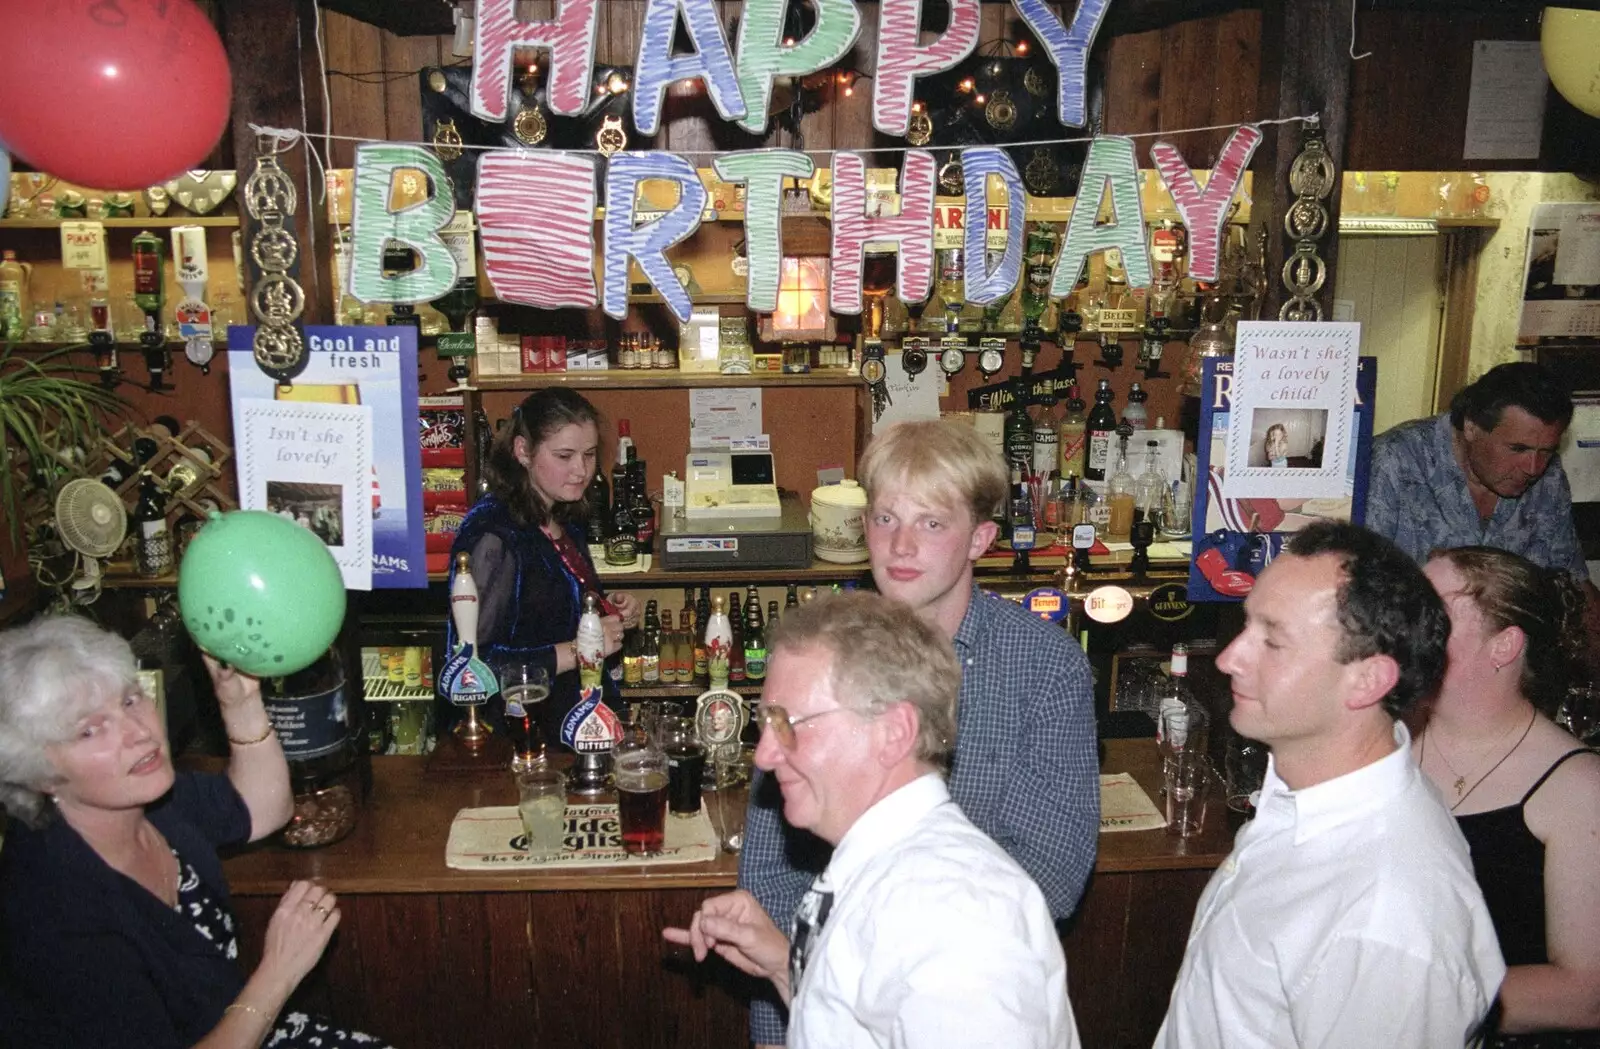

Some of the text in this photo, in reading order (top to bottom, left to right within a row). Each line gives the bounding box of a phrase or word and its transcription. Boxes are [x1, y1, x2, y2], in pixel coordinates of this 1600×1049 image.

[310, 336, 400, 352] Cool and
[1252, 344, 1344, 360] Wasn't she
[330, 353, 381, 368] fresh
[1260, 365, 1330, 384] a lovely
[1270, 386, 1318, 401] child!
[268, 427, 344, 444] Isn't she
[440, 656, 468, 691] ADNAMS
[454, 692, 487, 701] REGATTA
[564, 701, 595, 740] ADNAMS
